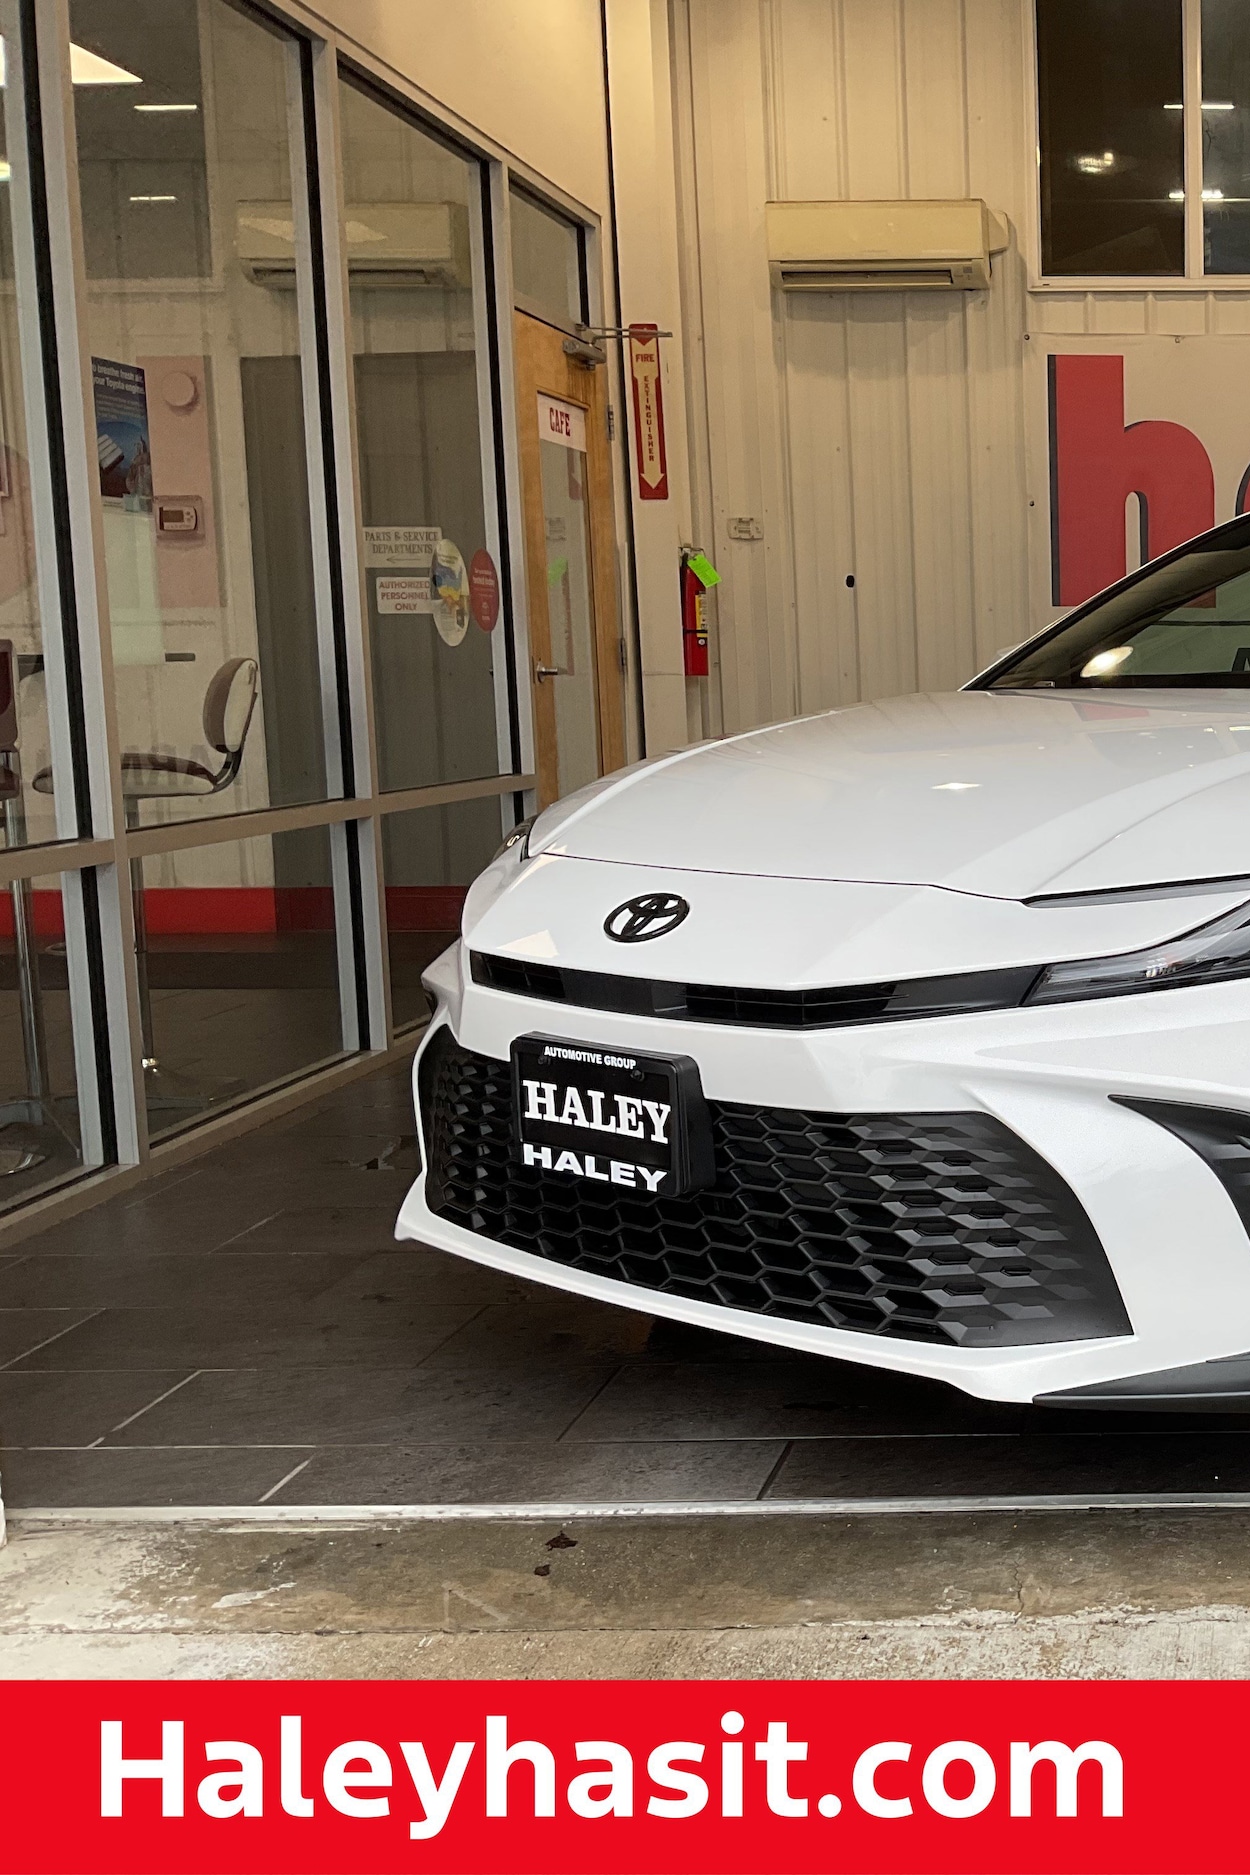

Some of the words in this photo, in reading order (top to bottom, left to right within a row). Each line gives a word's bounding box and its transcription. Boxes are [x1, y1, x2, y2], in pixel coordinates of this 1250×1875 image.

[635, 353, 655, 363] FIRE
[106, 377, 125, 390] Toyota
[549, 407, 571, 437] CAFE
[643, 375, 655, 461] EXTINGUISHER
[365, 531, 391, 542] PARTS
[402, 531, 439, 542] SERVICE
[372, 544, 433, 554] DEPARTMENTS
[379, 581, 431, 590] AUTHORIZED
[381, 592, 430, 600] PERSONNEL
[394, 602, 418, 612] ONLY
[544, 1046, 602, 1065] AUTOMOTIVE
[604, 1055, 637, 1070] GROUP
[523, 1080, 671, 1145] HALEY
[523, 1143, 668, 1193] HALEY
